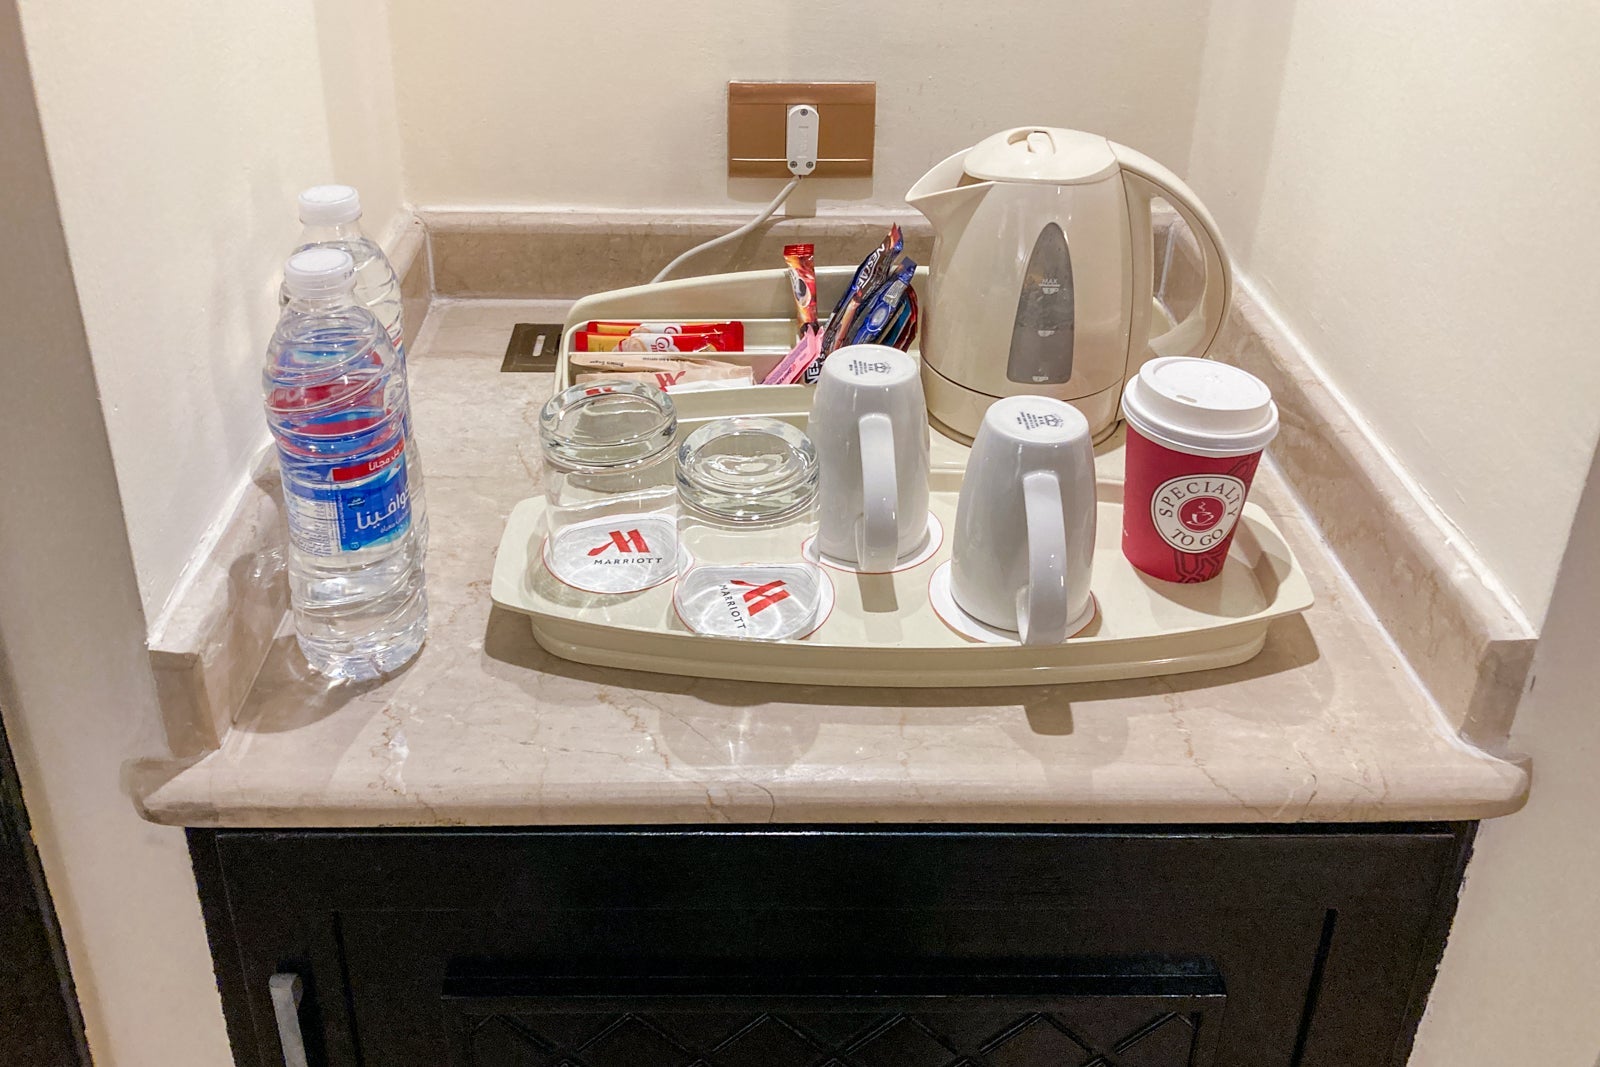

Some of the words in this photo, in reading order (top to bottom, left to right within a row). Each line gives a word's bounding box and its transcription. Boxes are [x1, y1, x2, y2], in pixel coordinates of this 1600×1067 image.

[1158, 481, 1241, 518] SPECIALTY
[1171, 528, 1195, 546] TO
[1199, 528, 1224, 546] GO
[593, 556, 664, 565] MARRIOTT
[719, 584, 746, 630] MARRIOTT
